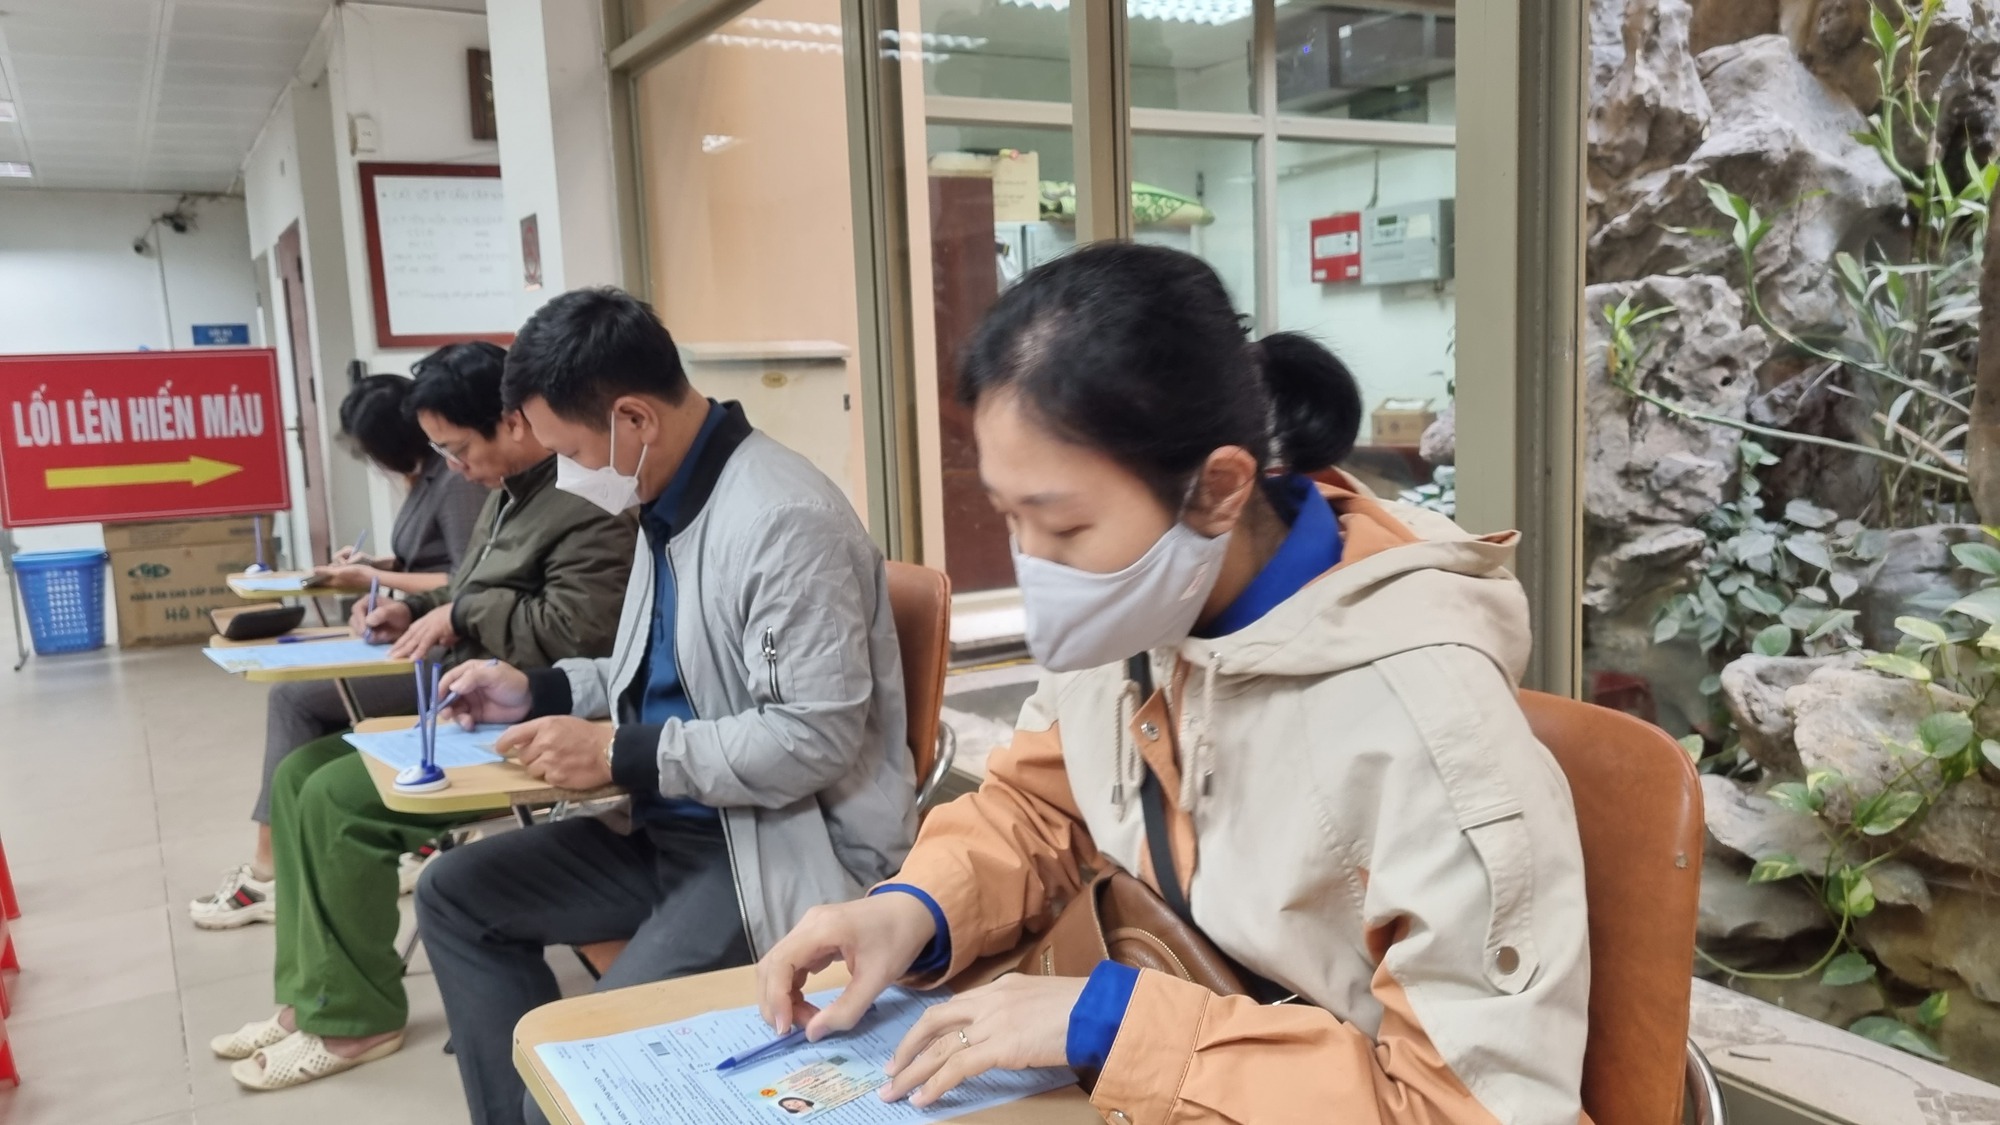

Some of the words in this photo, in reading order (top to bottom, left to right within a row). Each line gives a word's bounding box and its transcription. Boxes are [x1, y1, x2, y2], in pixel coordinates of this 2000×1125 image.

[12, 384, 61, 447] LỐI
[66, 388, 123, 444] LÊN
[128, 379, 196, 442] HIẾN
[200, 384, 264, 437] MÁU
